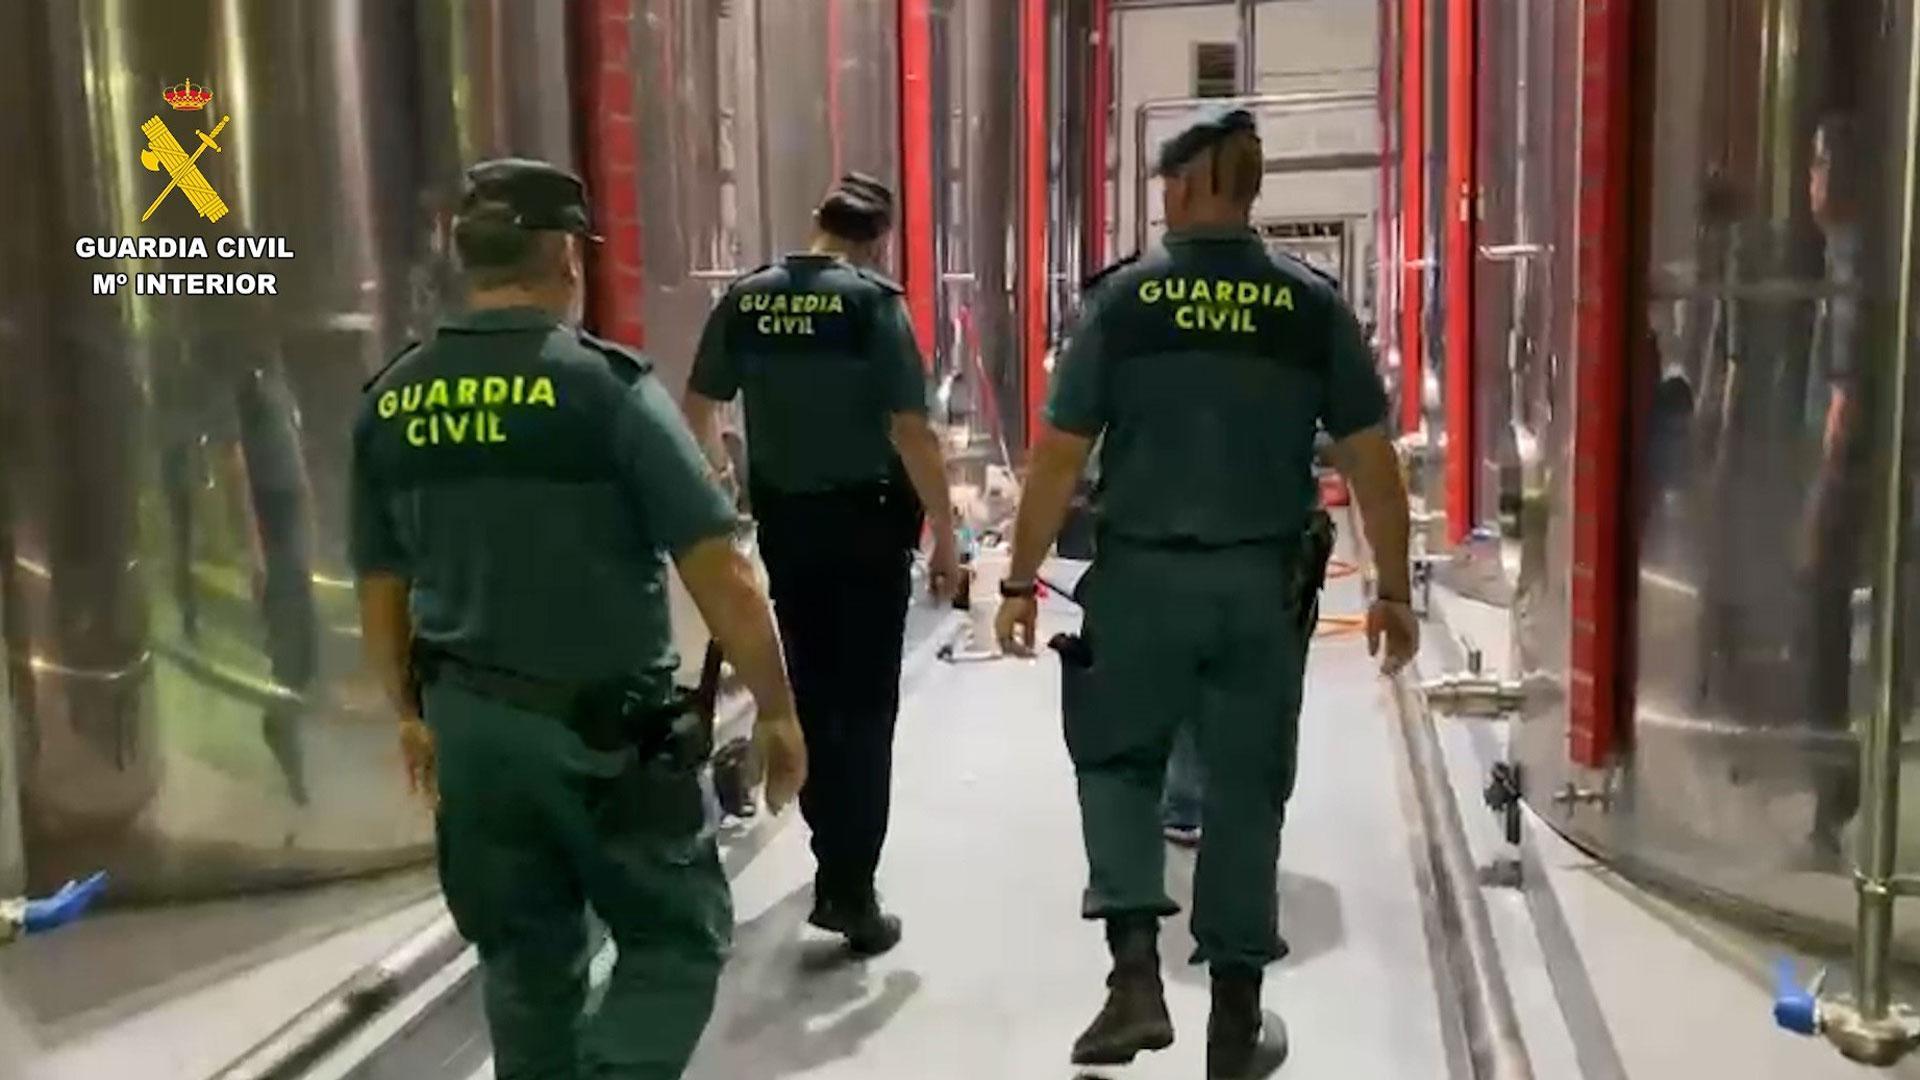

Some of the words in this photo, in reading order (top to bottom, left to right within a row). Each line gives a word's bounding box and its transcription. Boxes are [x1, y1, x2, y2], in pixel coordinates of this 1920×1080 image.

[739, 293, 843, 313] GUARDIA
[1138, 277, 1295, 311] GUARDIA
[757, 315, 815, 335] CIVIL
[1174, 305, 1257, 333] CIVIL
[377, 375, 557, 419] GUARDIA
[406, 411, 507, 447] CIVIL
